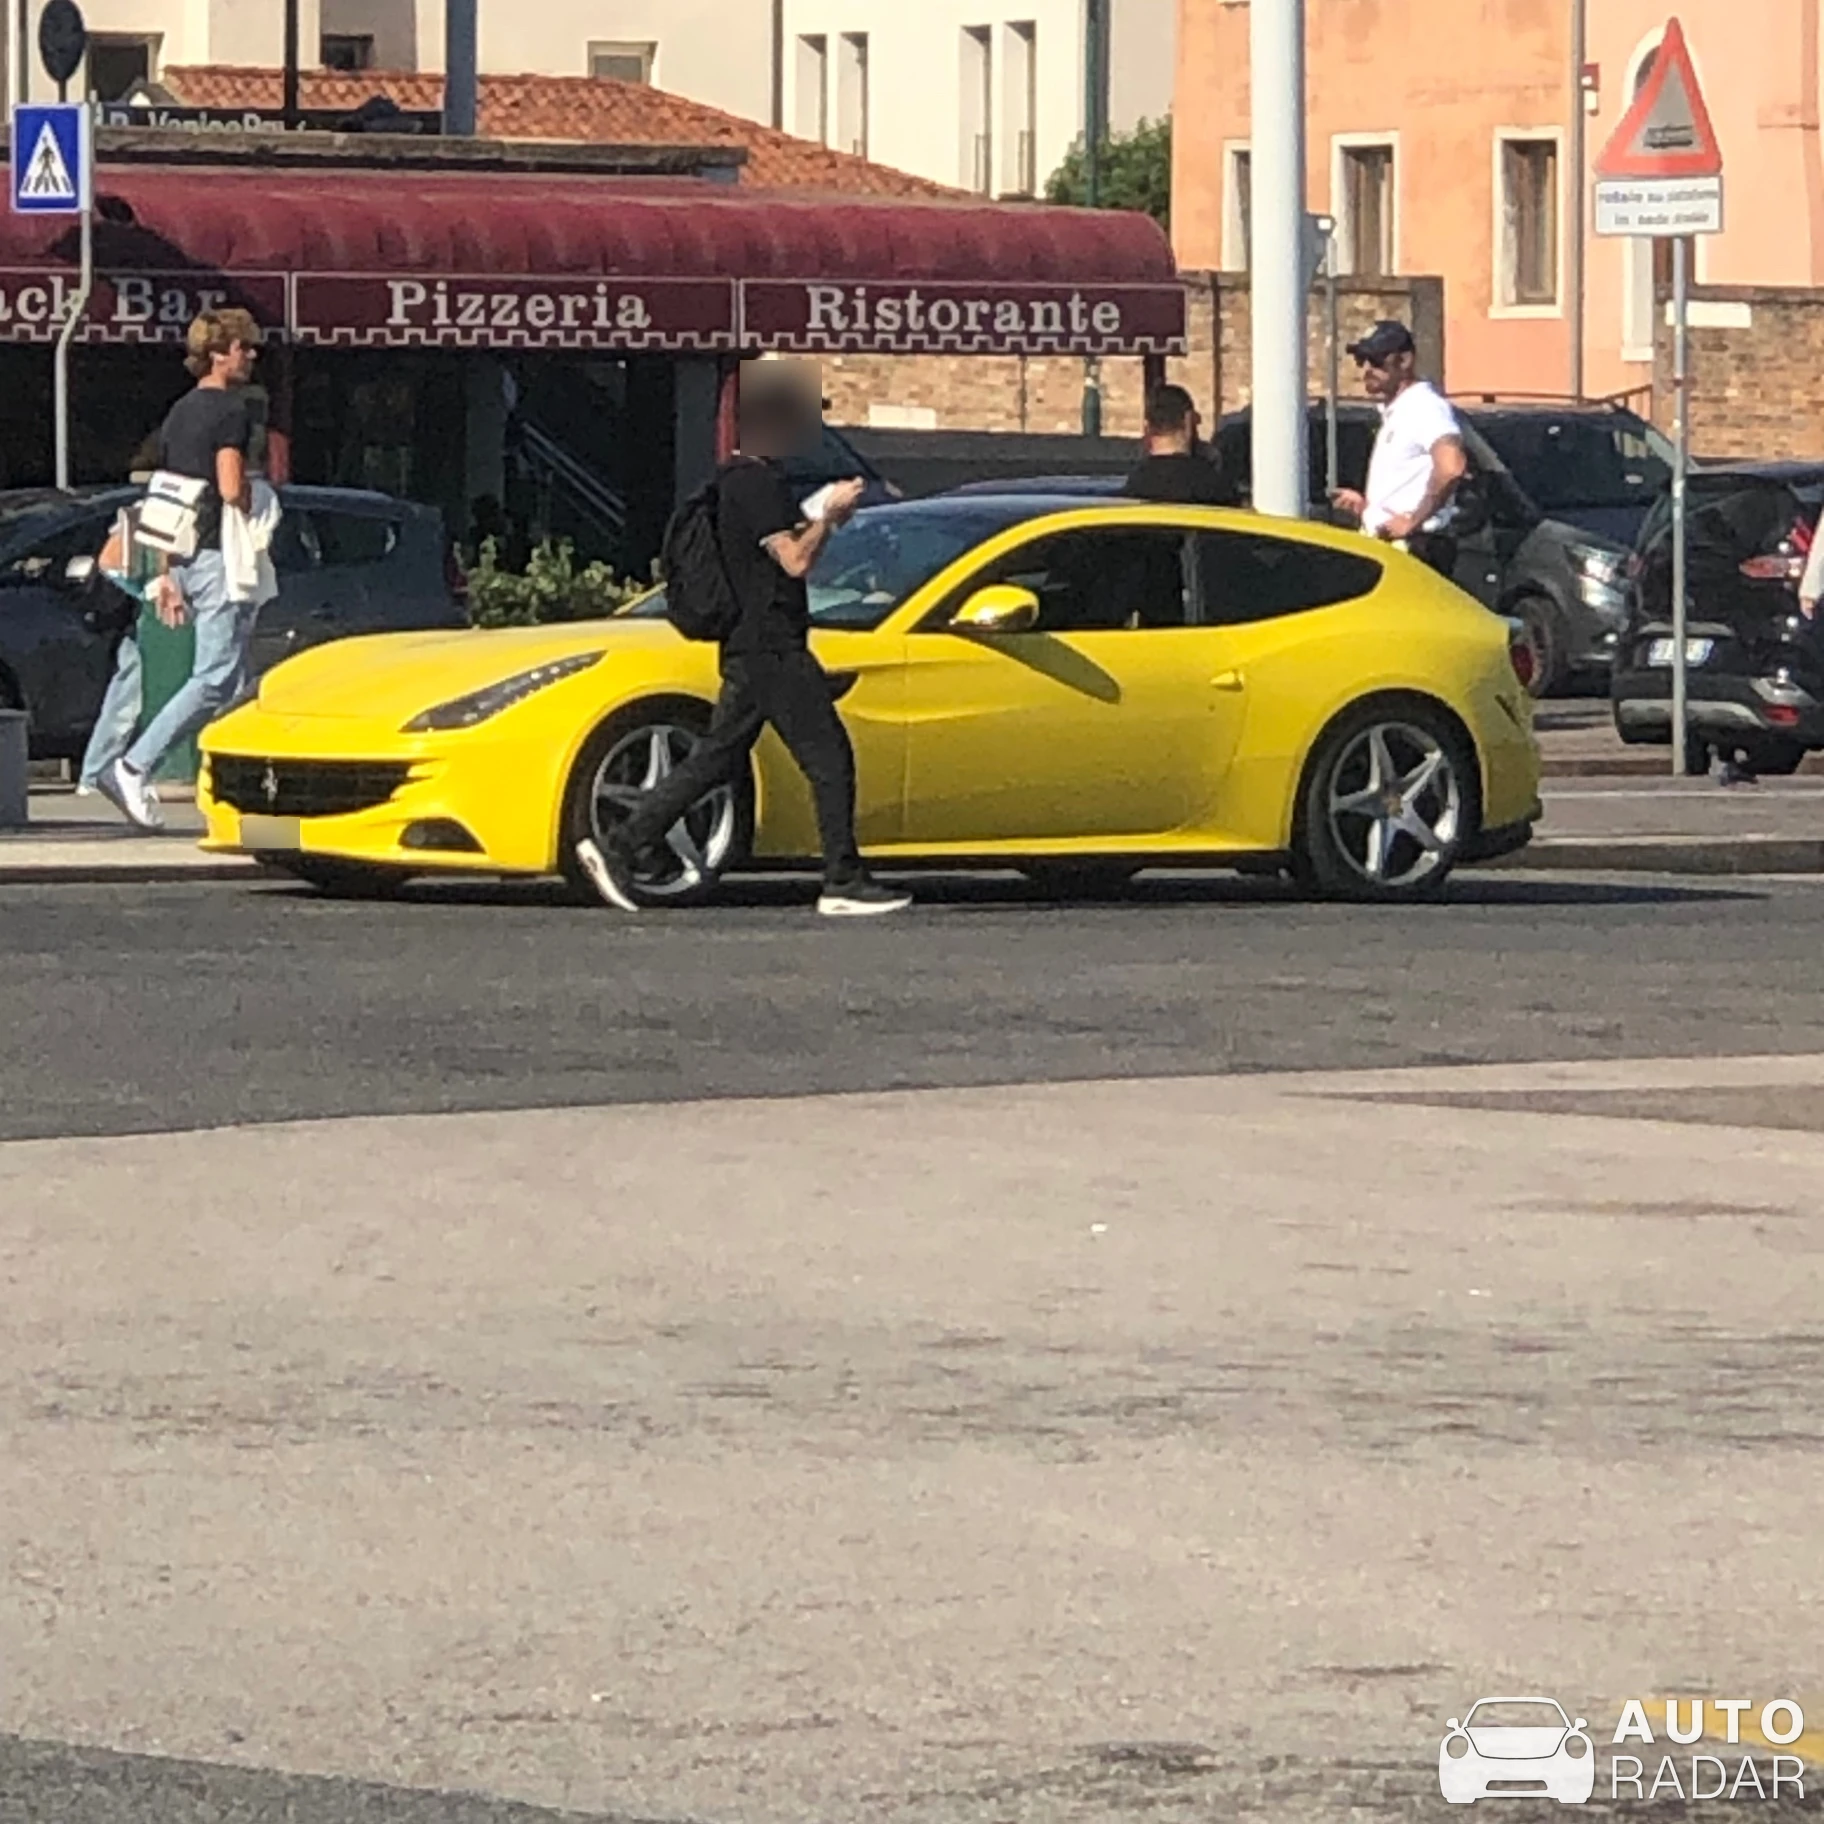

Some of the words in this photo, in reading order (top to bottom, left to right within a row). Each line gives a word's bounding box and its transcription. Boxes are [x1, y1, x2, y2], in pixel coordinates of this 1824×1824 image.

[110, 276, 228, 323] Bar
[386, 280, 652, 329] Pizzeria
[806, 285, 1121, 334] Ristorante
